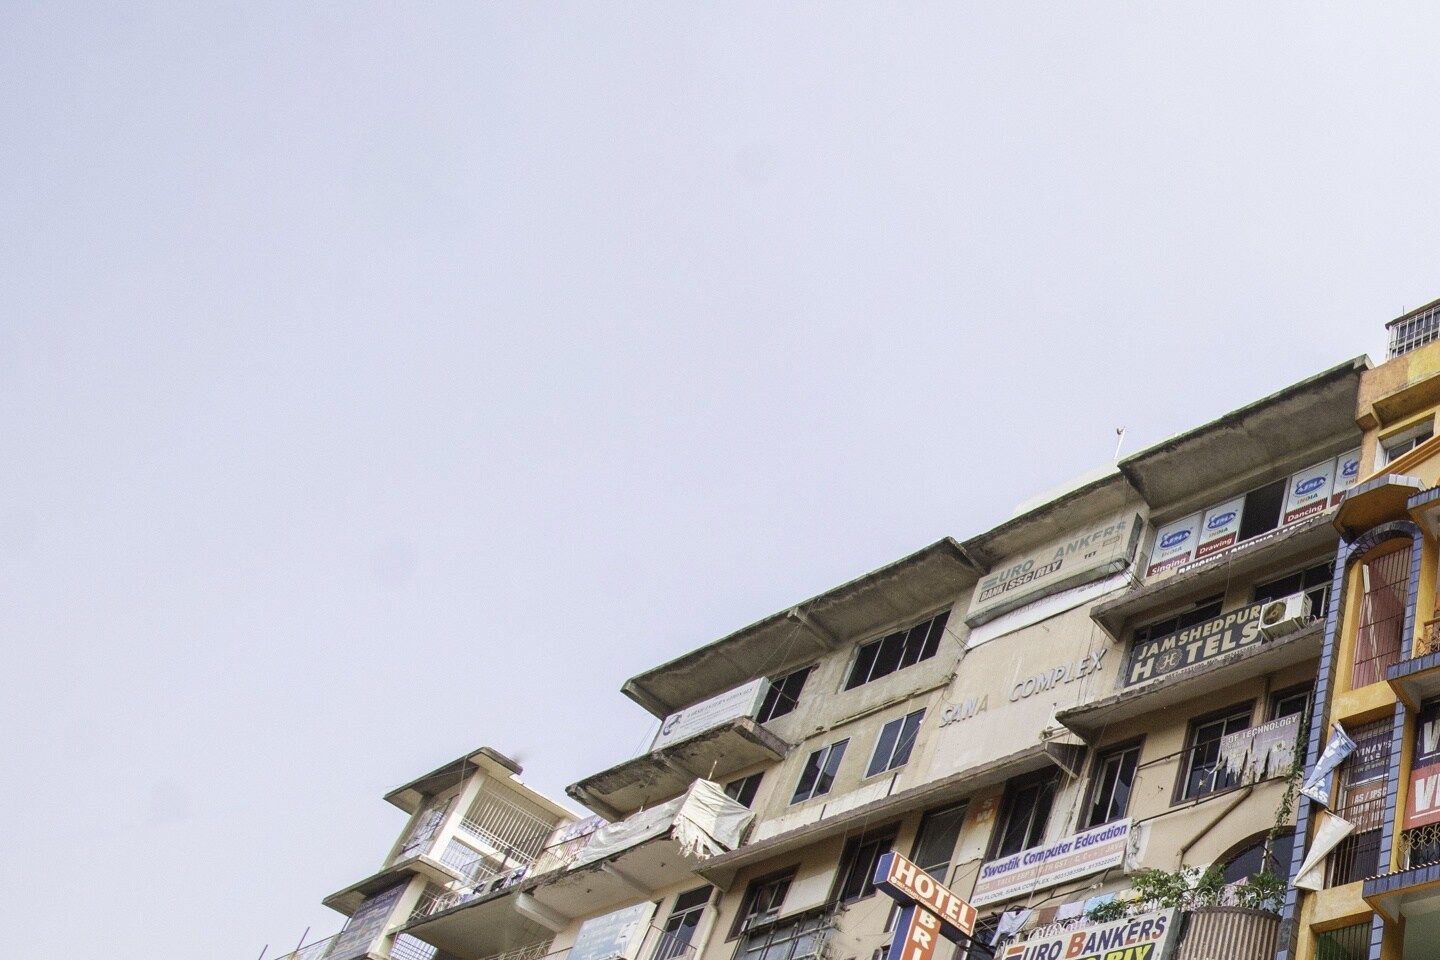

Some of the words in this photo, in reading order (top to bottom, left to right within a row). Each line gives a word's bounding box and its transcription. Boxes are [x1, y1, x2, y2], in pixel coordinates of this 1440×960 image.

[1287, 505, 1323, 522] Dancing
[1151, 558, 1186, 575] Singing
[1199, 538, 1232, 554] Drawing
[1138, 605, 1262, 660] JAMSHEDPUR
[939, 694, 989, 728] SANA
[1008, 649, 1107, 703] COMPLEX
[982, 857, 1021, 879] Swastik
[1023, 842, 1072, 865] Computer
[1074, 823, 1127, 850] Education
[894, 858, 969, 929] HOTEL
[1065, 916, 1167, 959] BANKERS
